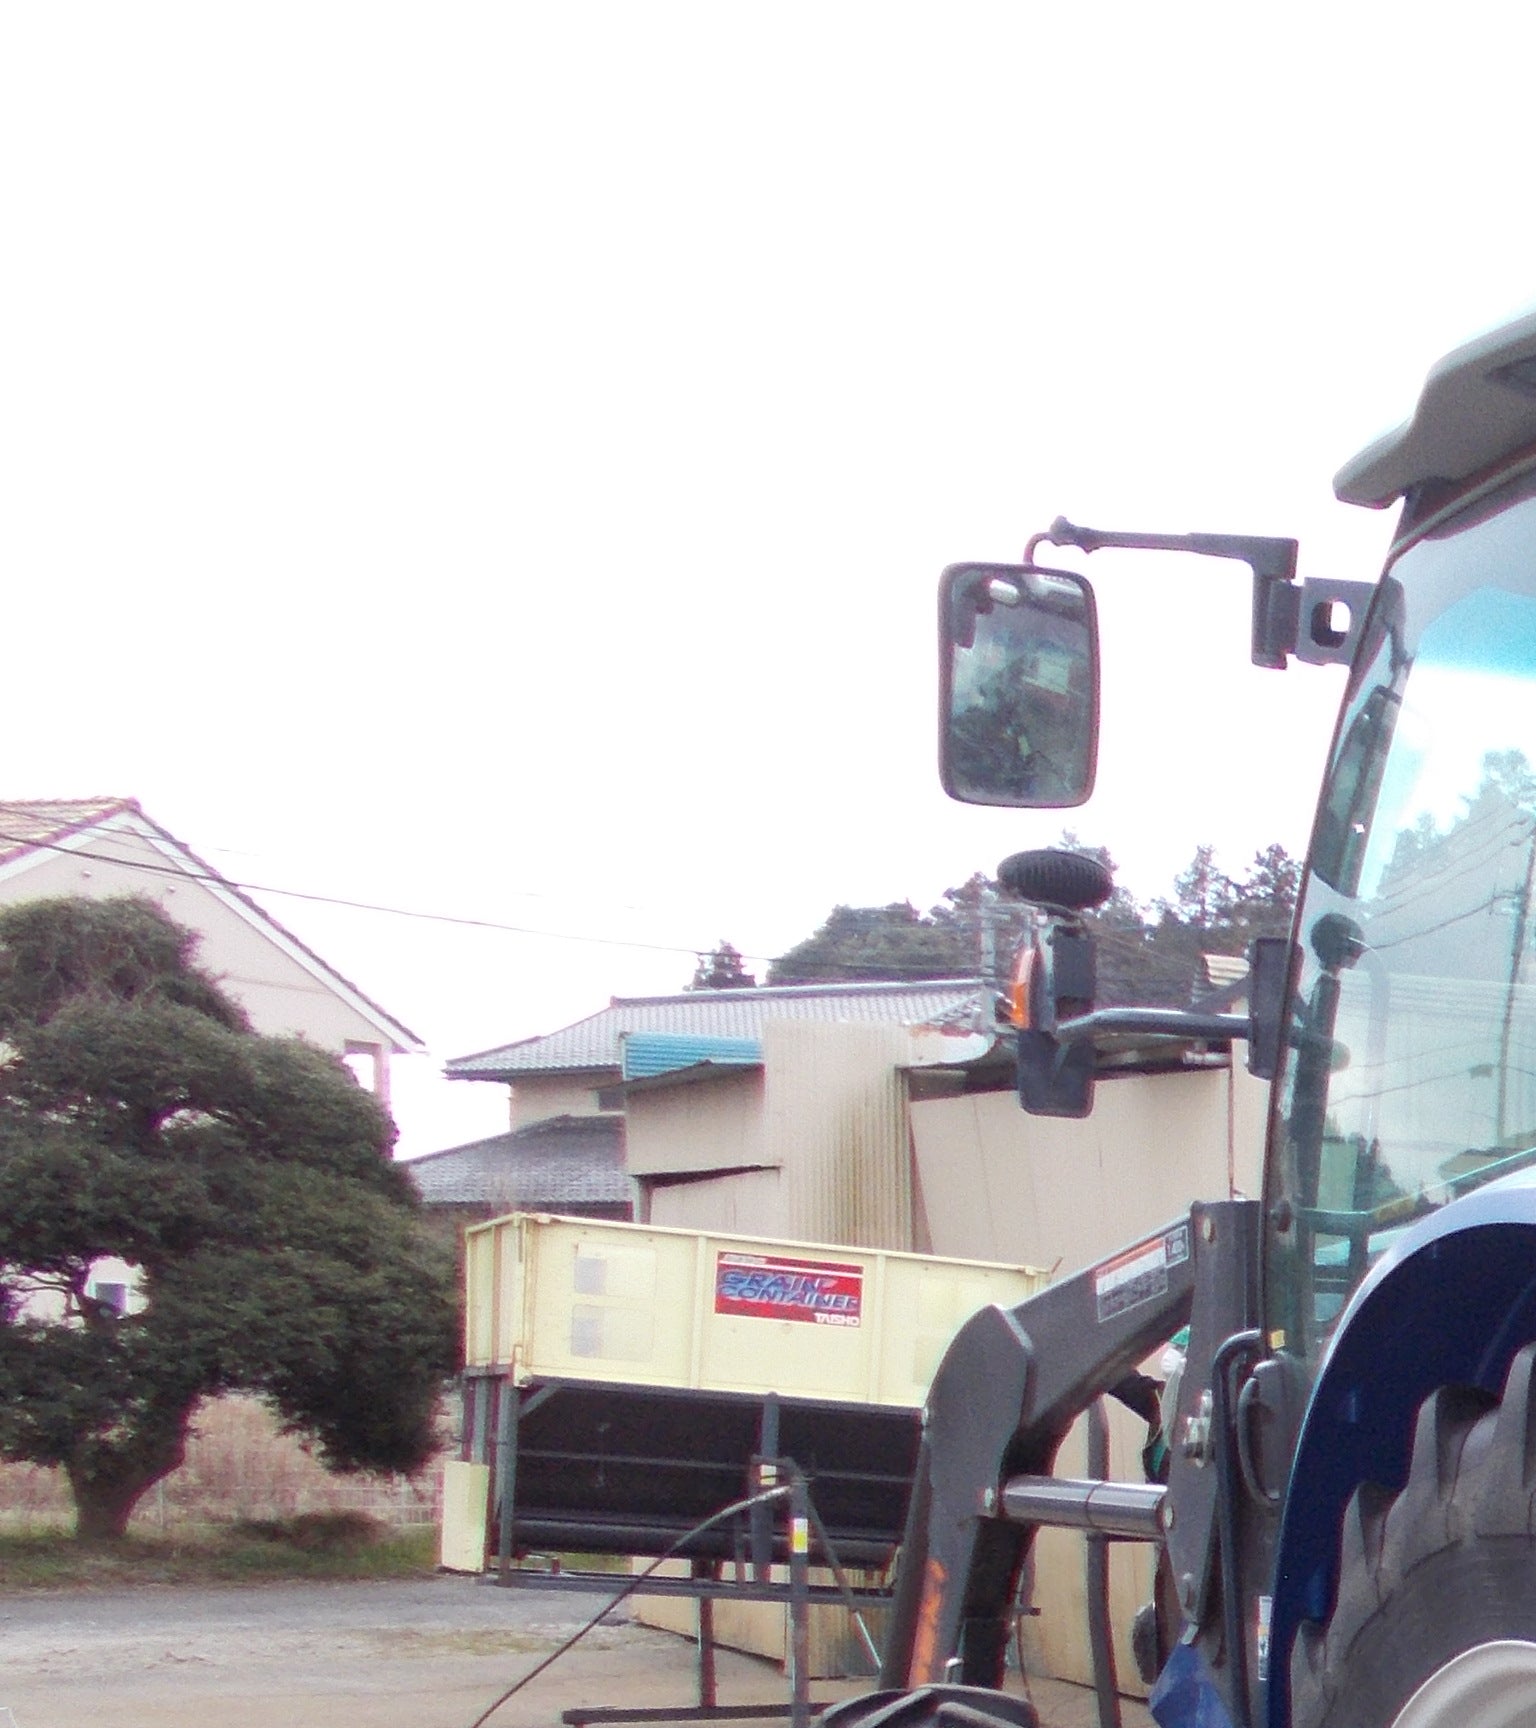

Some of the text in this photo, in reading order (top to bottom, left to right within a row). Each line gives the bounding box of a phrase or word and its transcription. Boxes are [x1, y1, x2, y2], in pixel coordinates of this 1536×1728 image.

[721, 1269, 821, 1292] GRAIN
[719, 1284, 859, 1310] CONTAINER
[814, 1312, 860, 1327] TAISHO
